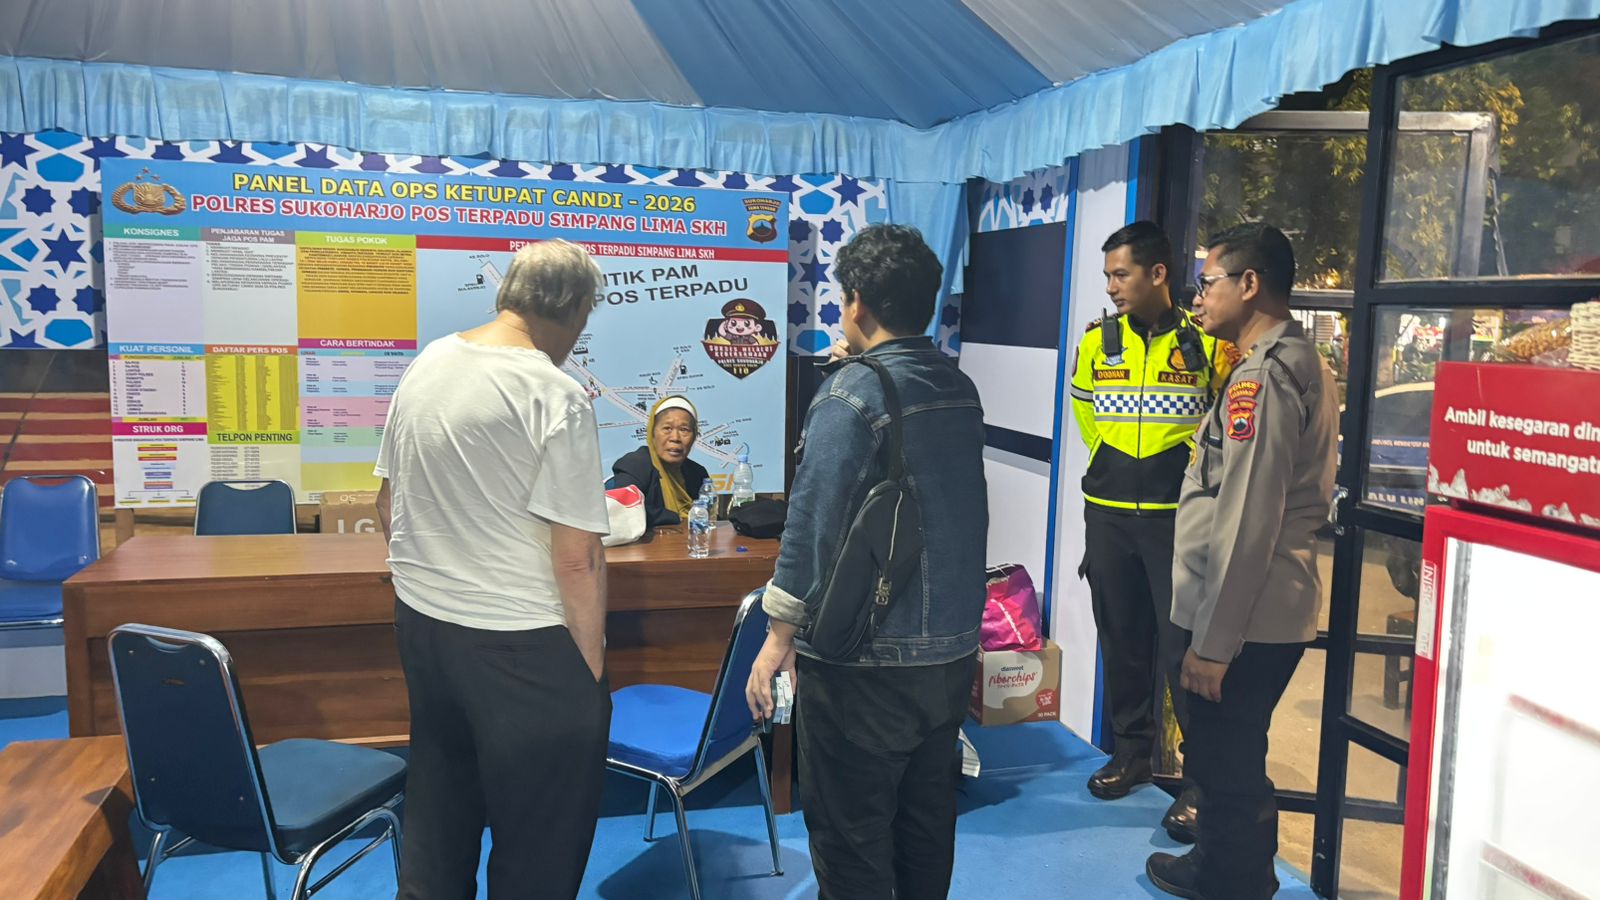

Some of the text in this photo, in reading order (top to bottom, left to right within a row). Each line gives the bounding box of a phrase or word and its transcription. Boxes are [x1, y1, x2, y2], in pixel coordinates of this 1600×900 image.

[233, 173, 314, 194] PANEL
[320, 178, 385, 197] DATA
[390, 181, 438, 200] OPS
[444, 184, 546, 205] KETUPAT
[552, 190, 623, 208] CANDI
[643, 195, 696, 213] 2026
[192, 195, 727, 236] POLRES SUKOHARJO POS TERPADU SIMPANG LIMA SKH
[123, 228, 179, 237] KONSIGNES
[325, 235, 388, 245] TUGAS POKOK
[509, 241, 529, 250] PET
[598, 244, 635, 256] TERPADU
[637, 246, 675, 257] SIMPANG
[676, 248, 696, 258] LIMA
[698, 249, 715, 259] SKH
[603, 264, 699, 287] ITIK PAM
[644, 277, 748, 301] TERPADU
[320, 339, 345, 347] CARA
[147, 345, 194, 353] PERSONIL
[1161, 373, 1194, 384] KASAT
[1443, 406, 1487, 427] Ambil
[1489, 410, 1570, 438] kesegaran
[132, 425, 184, 433] STRUK ORG
[216, 433, 293, 441] TELPON PENTING
[1466, 439, 1510, 459] untuk
[1368, 492, 1396, 503] ALU
